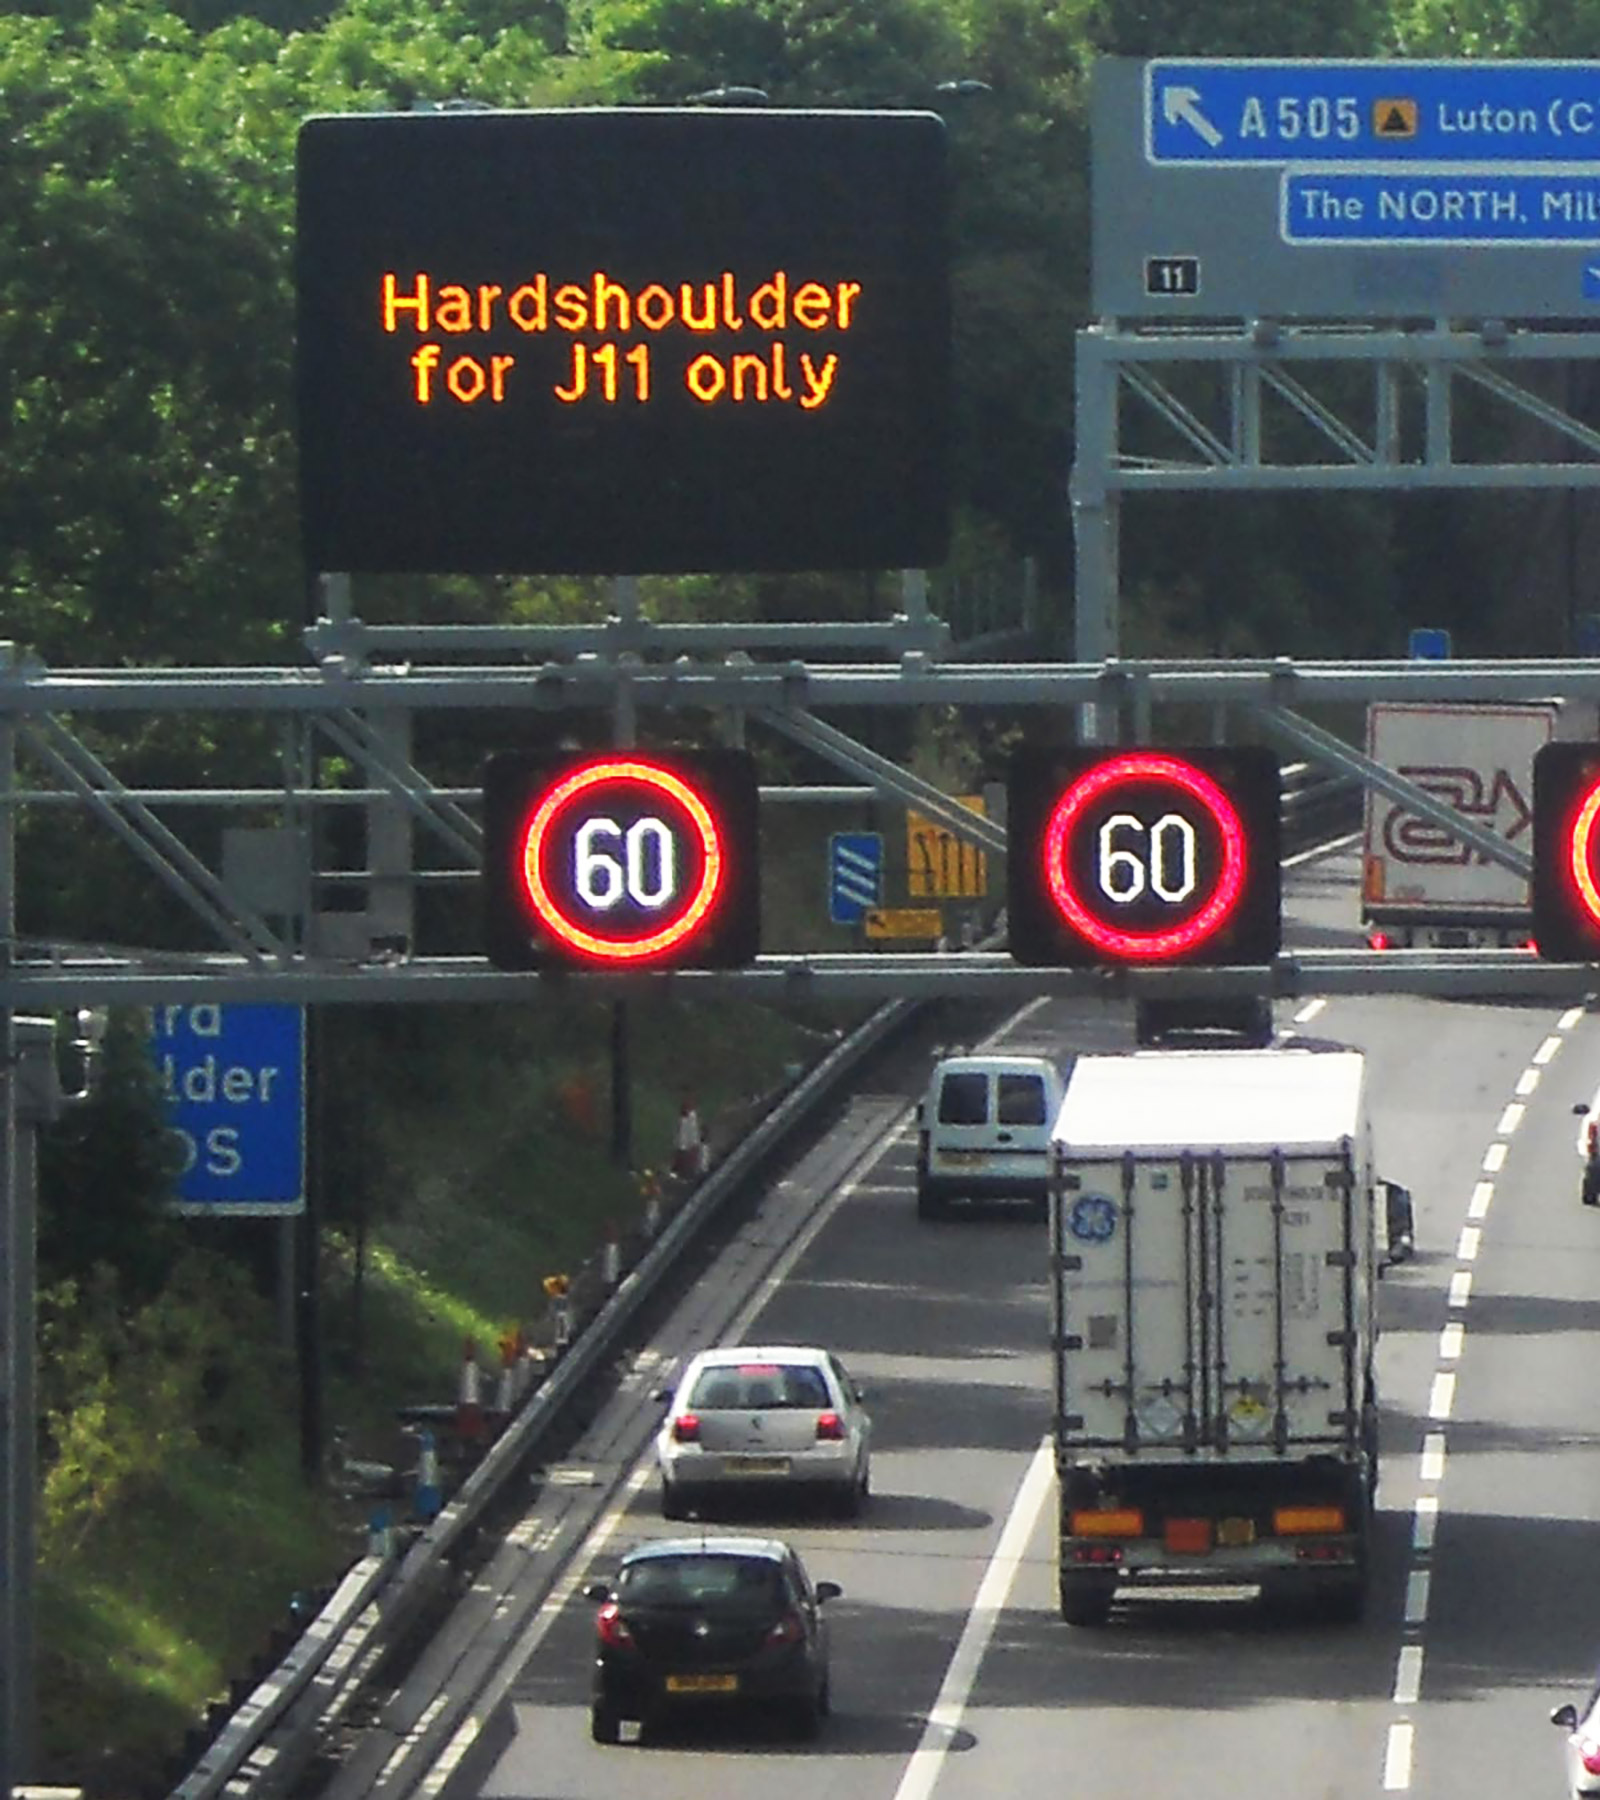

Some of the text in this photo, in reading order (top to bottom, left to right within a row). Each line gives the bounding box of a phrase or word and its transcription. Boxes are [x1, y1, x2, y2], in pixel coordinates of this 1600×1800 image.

[1438, 103, 1538, 132] Luton
[1300, 189, 1364, 220] The
[380, 270, 862, 334] Hardshoulder
[1161, 266, 1184, 290] 11
[409, 340, 839, 410] for J11 only
[573, 816, 677, 910] 60
[1097, 813, 1197, 905] 60
[162, 1054, 279, 1102] lder
